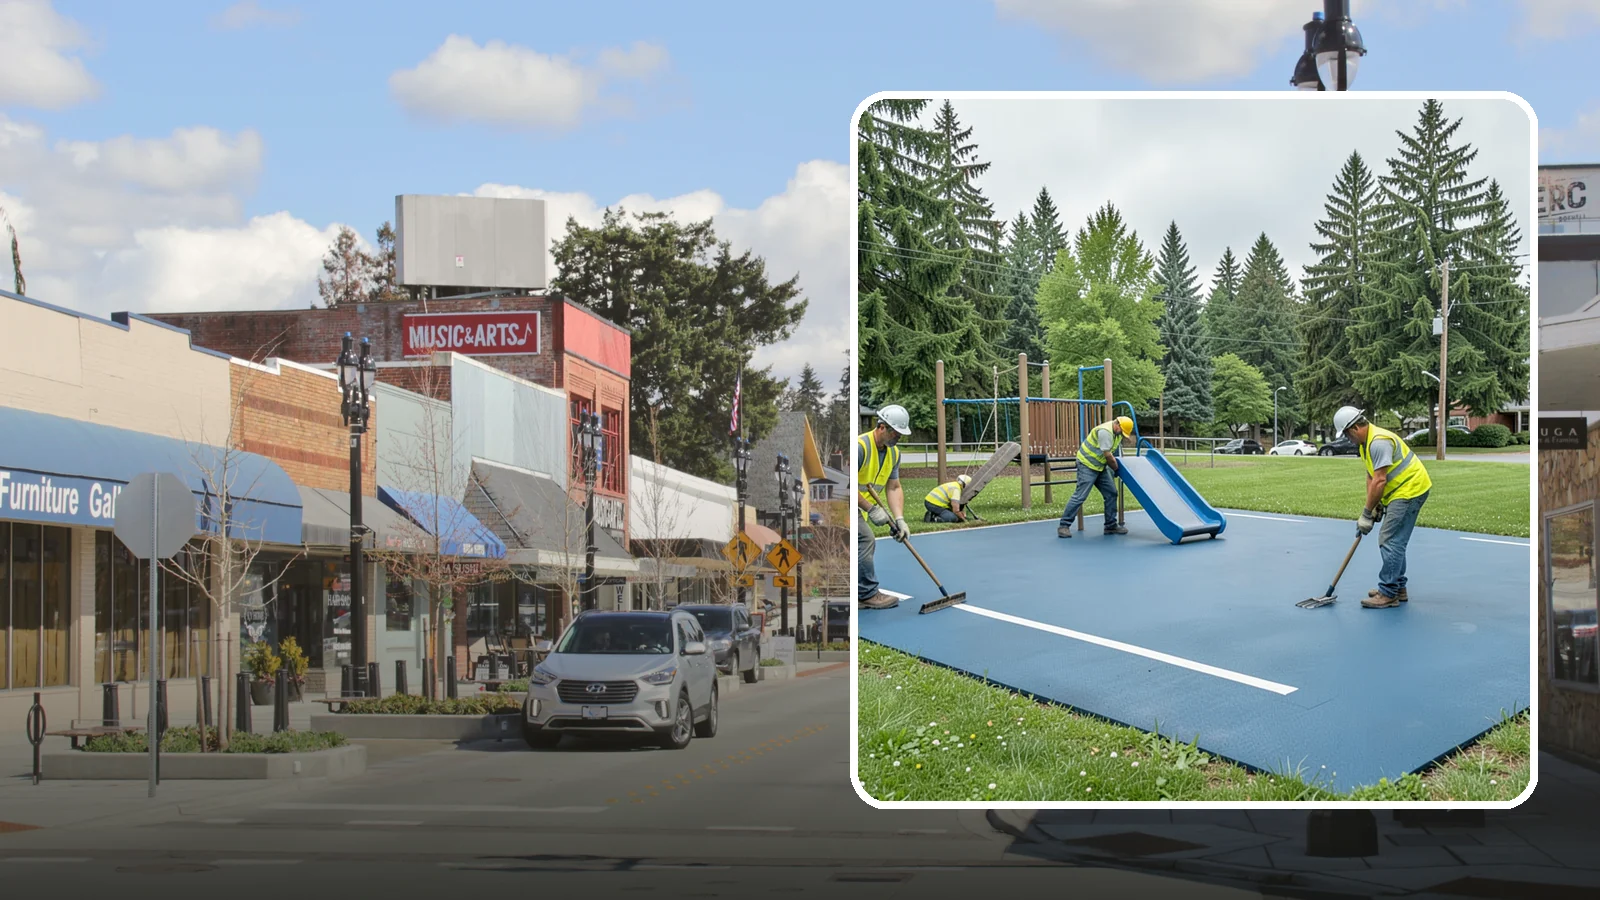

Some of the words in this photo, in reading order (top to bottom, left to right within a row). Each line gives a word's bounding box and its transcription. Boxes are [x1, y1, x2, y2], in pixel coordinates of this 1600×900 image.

[409, 323, 519, 348] MUSIC&ARTS
[1540, 428, 1577, 436] UGA
[0, 471, 79, 515] Furniture
[453, 563, 479, 574] SUSHI
